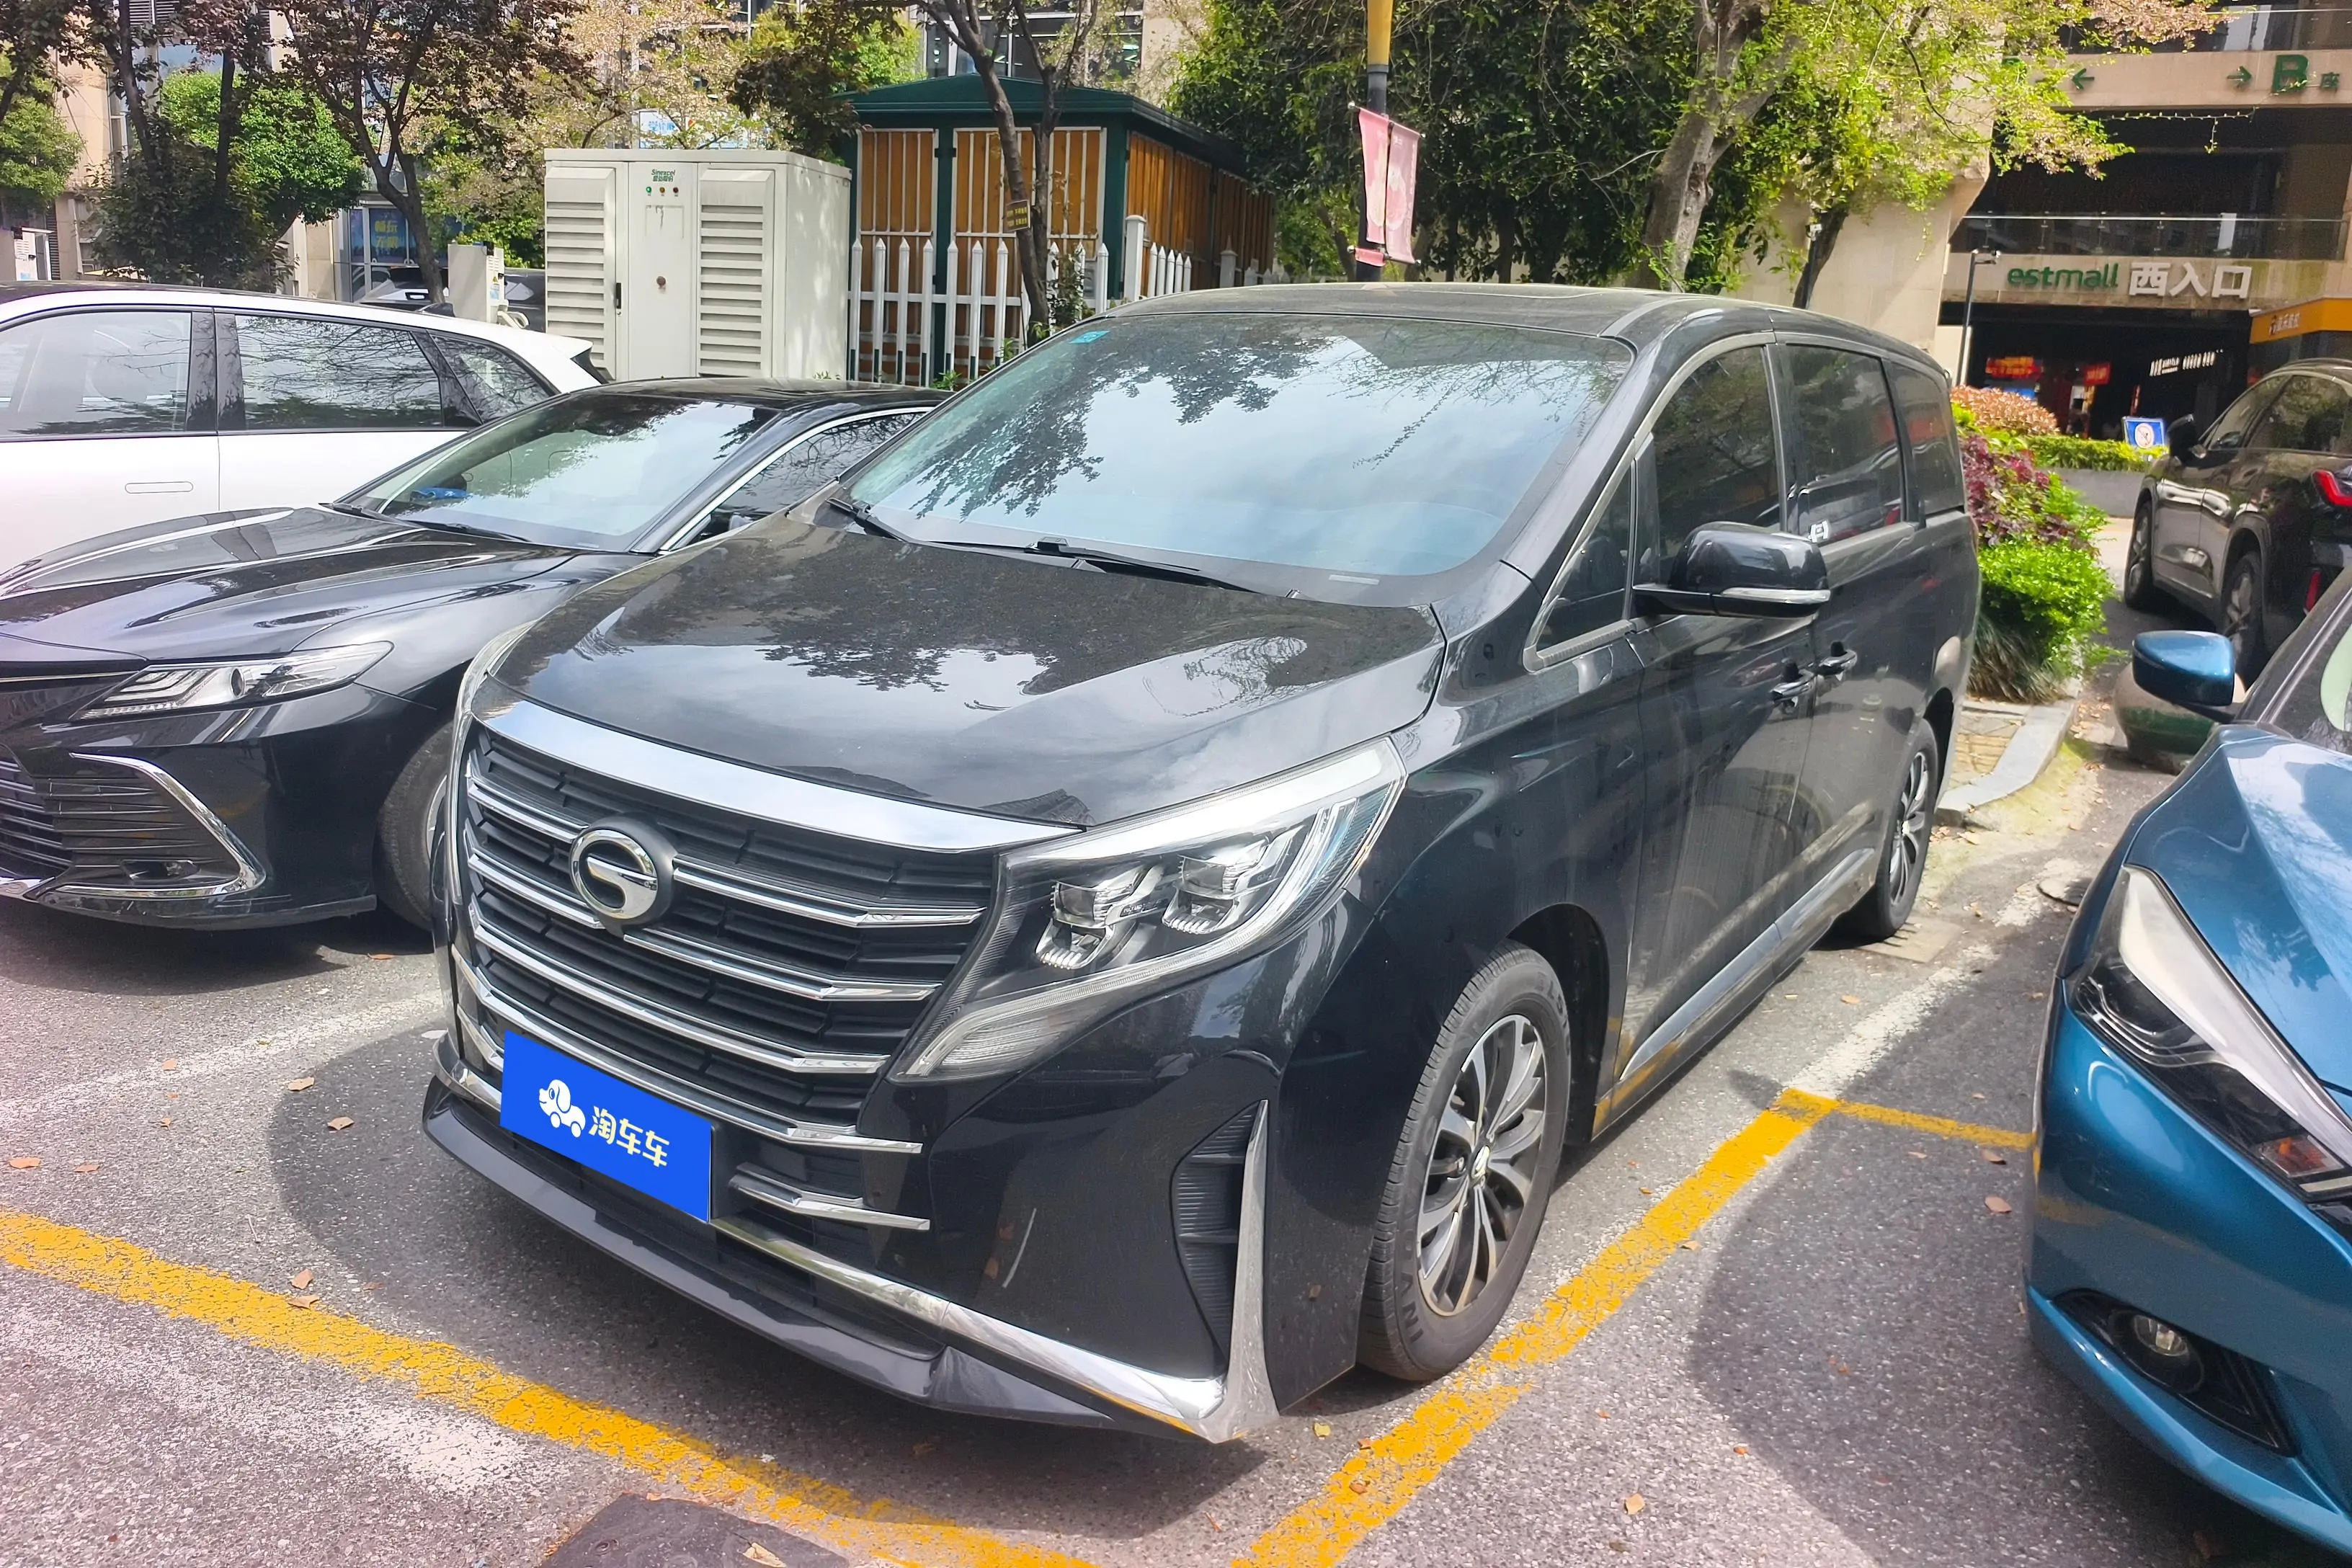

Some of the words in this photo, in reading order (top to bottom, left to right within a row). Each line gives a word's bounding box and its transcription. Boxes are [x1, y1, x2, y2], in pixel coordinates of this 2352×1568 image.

[2272, 54, 2309, 94] B
[2008, 263, 2119, 289] estmall
[2129, 262, 2253, 299] 西入口
